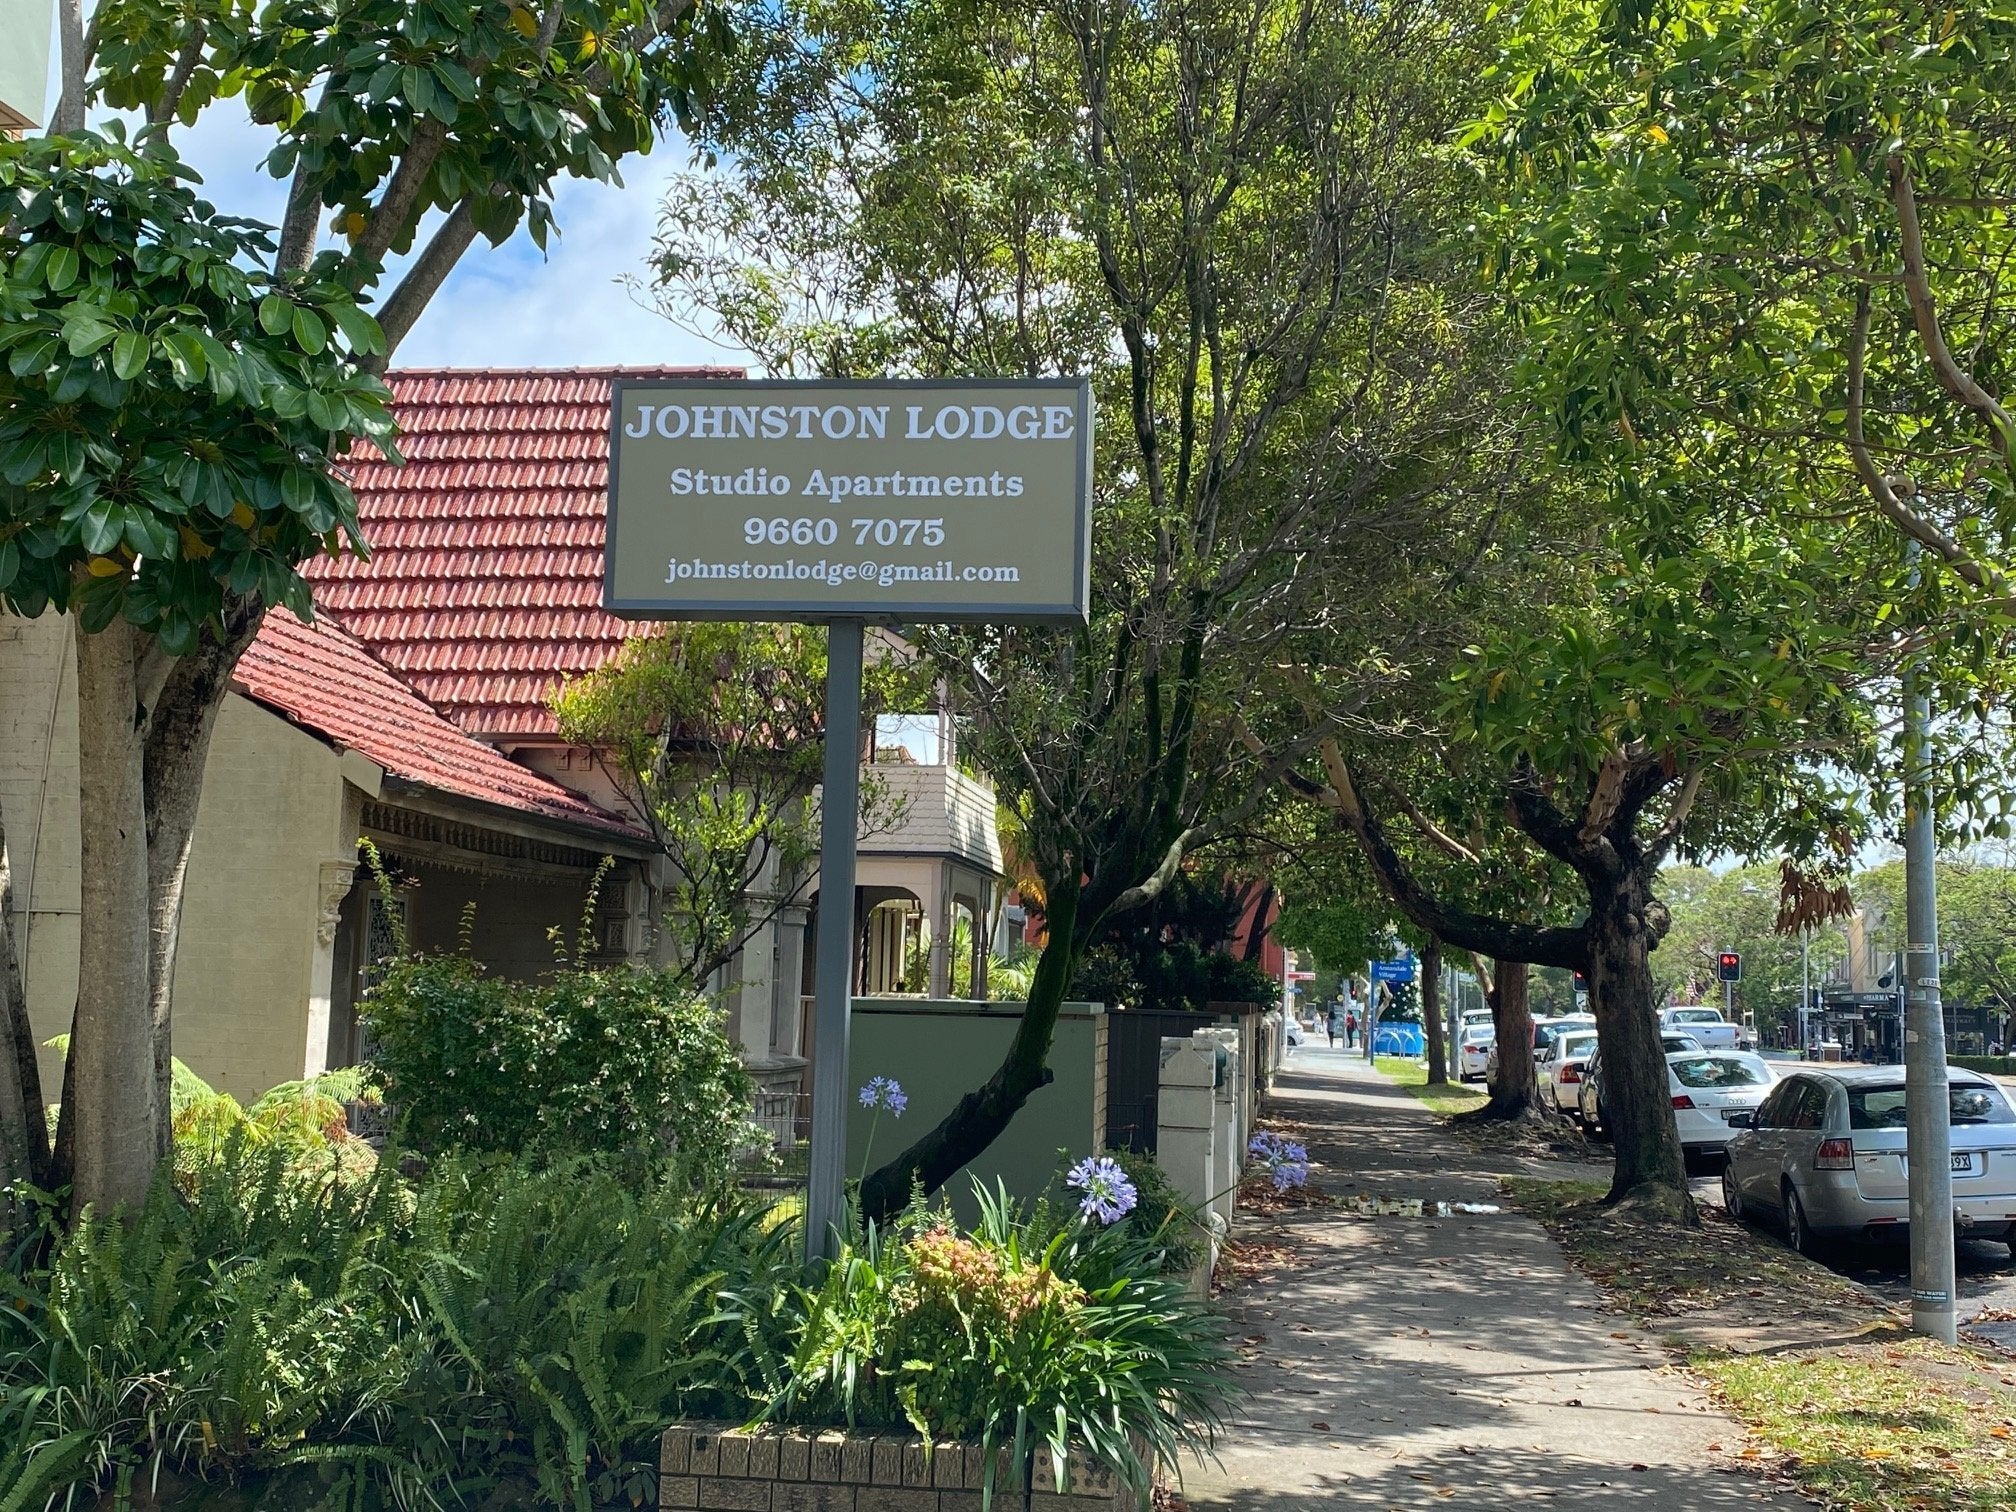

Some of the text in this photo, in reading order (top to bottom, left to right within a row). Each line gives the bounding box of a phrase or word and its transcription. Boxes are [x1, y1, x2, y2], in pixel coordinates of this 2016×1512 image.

[625, 405, 1074, 439] JOHNSTON LODGE
[671, 467, 1023, 503] Studio Apartments
[744, 518, 945, 546] 9660 7075
[665, 558, 1020, 586] johnstonlodge@gmail.com
